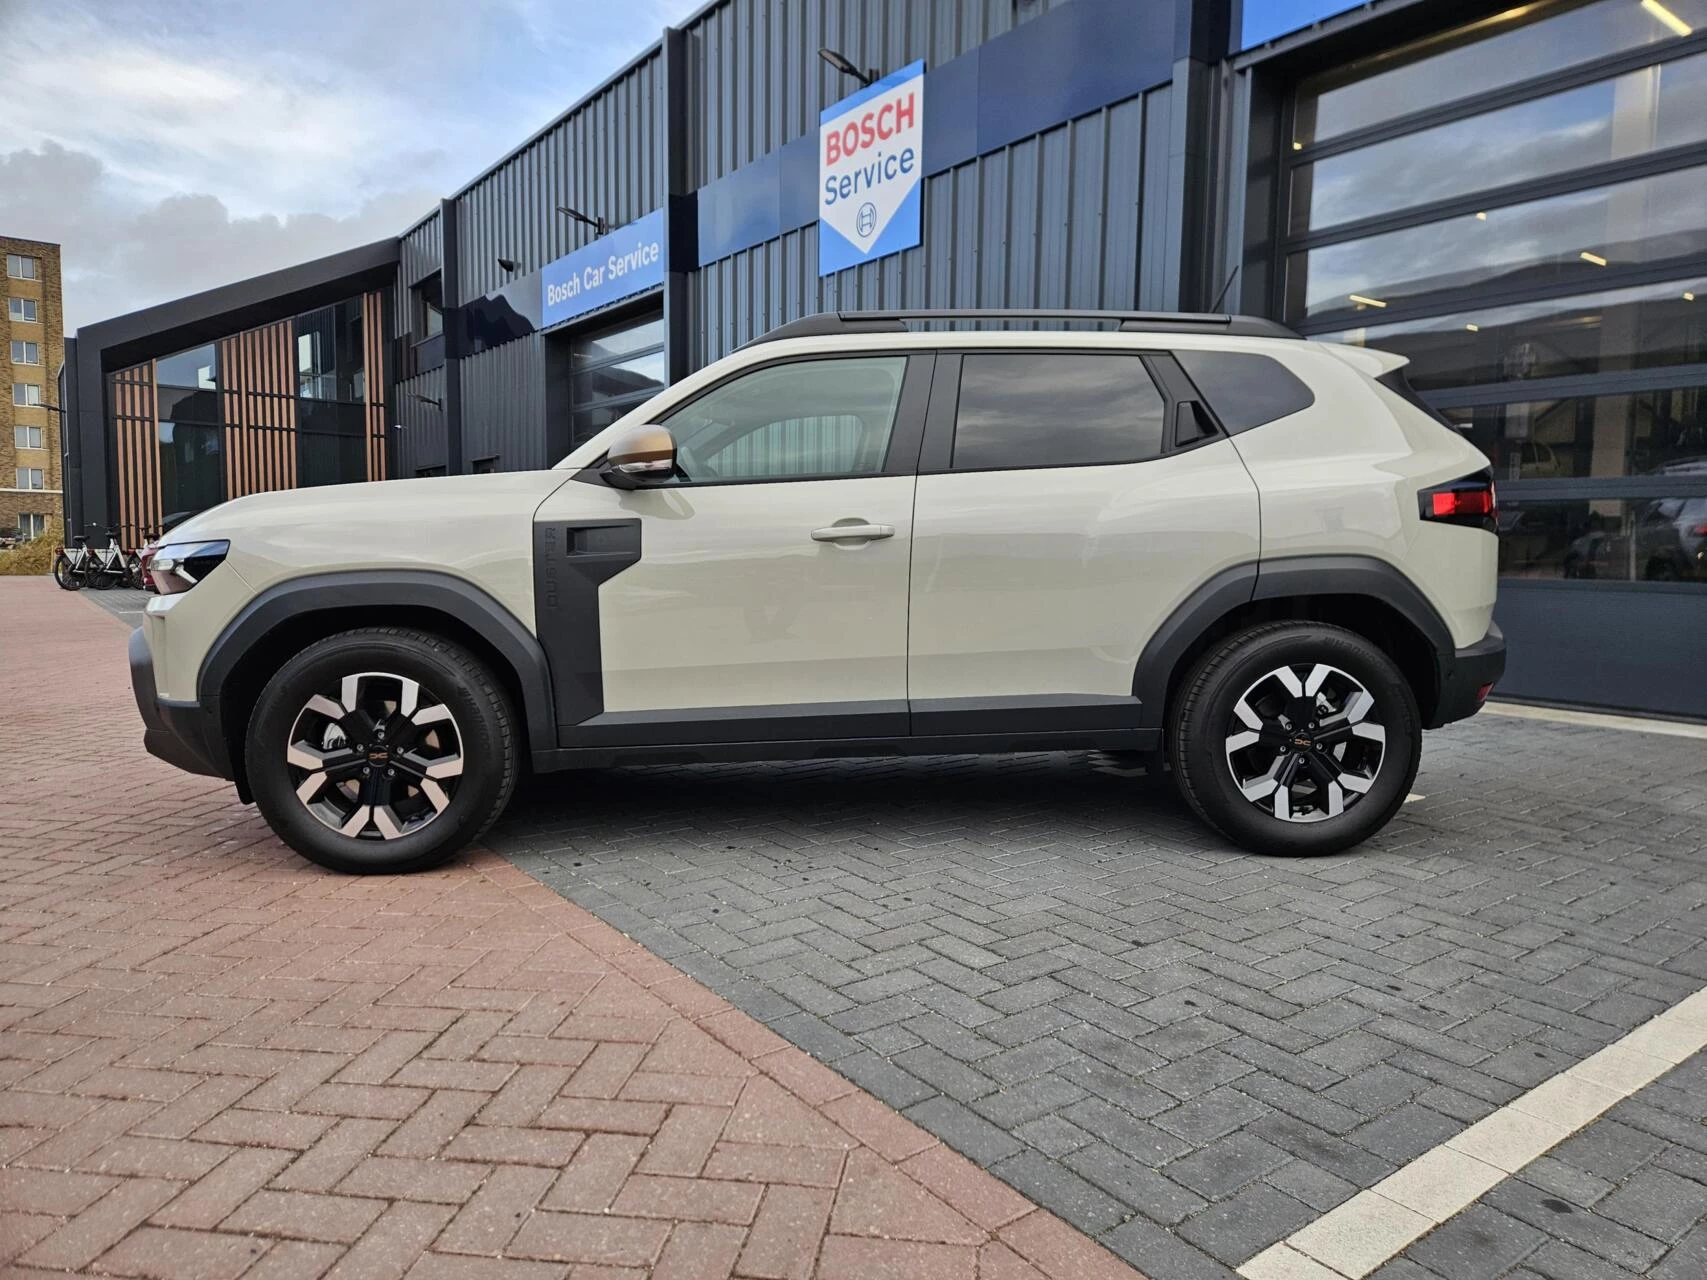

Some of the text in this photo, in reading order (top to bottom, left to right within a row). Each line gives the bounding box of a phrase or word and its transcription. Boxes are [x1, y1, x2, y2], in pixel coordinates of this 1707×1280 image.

[826, 92, 915, 167] BOSCH
[824, 147, 915, 205] Service
[547, 241, 659, 306] Bosch Car Service
[545, 527, 558, 608] DUSTER
